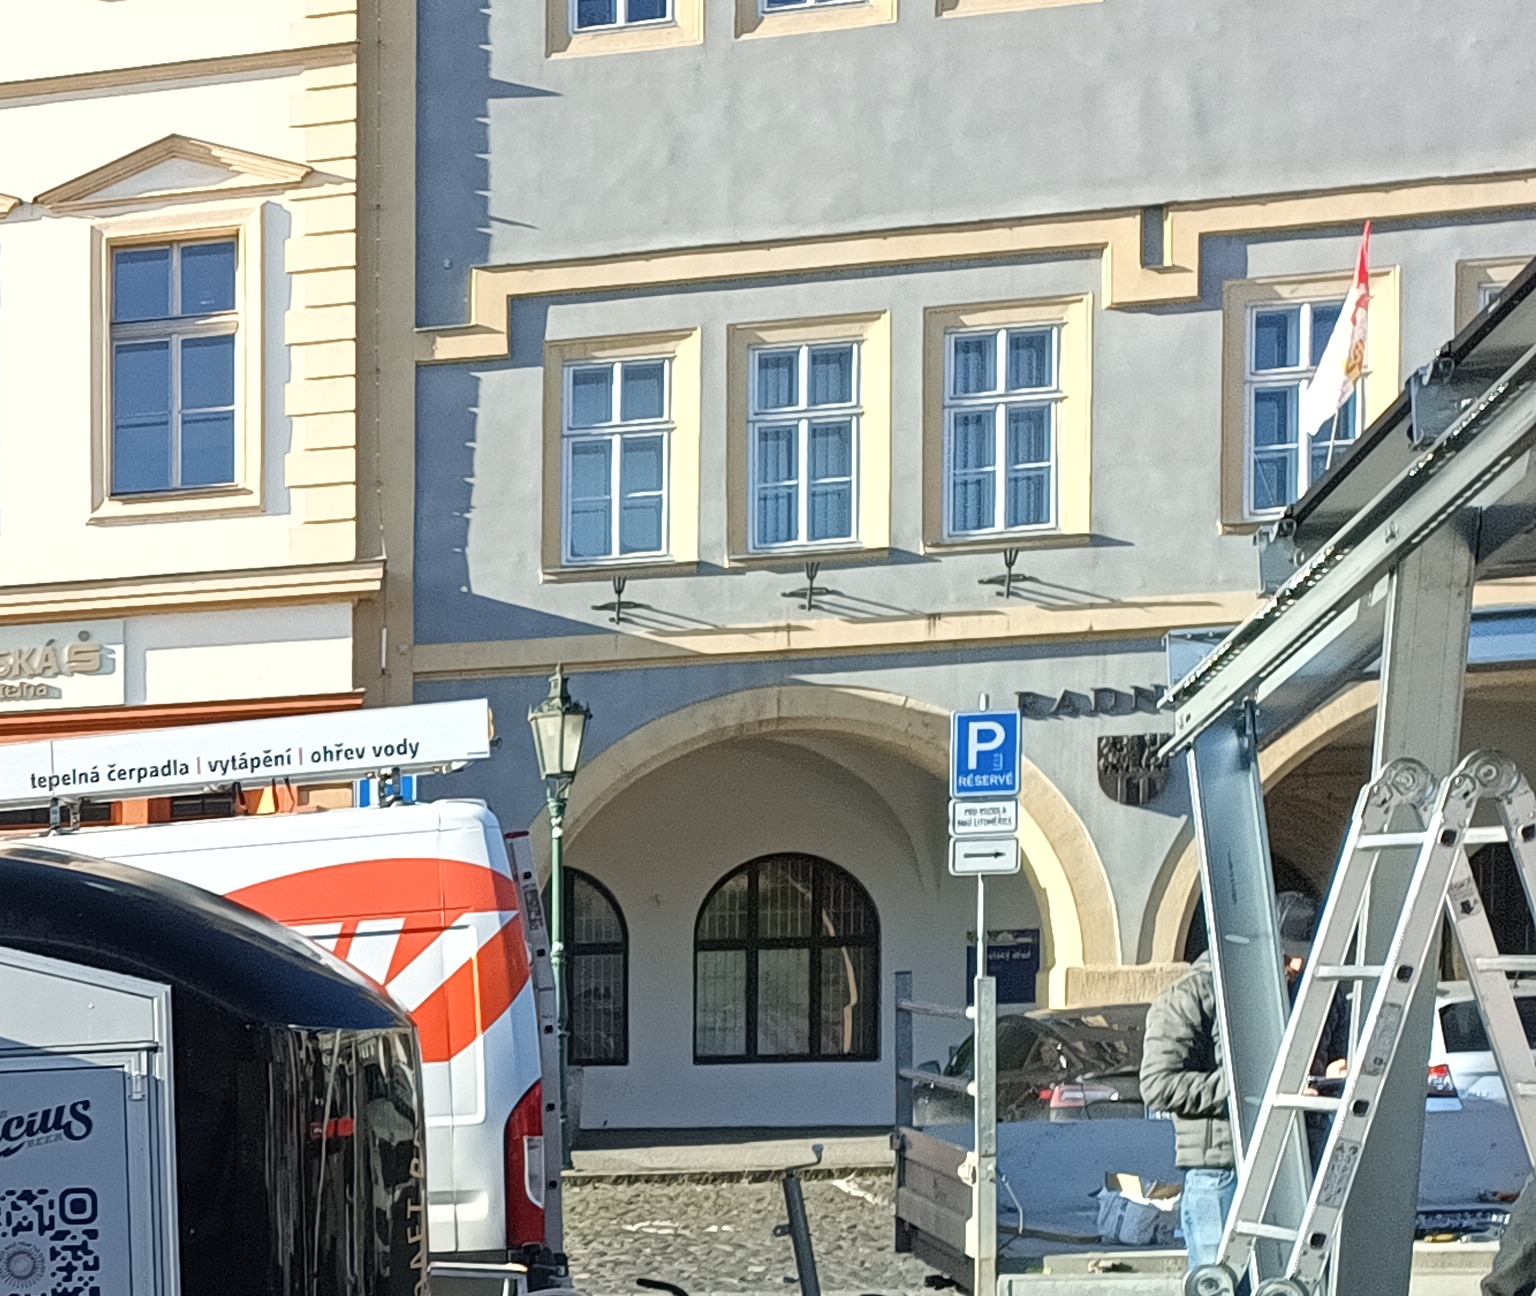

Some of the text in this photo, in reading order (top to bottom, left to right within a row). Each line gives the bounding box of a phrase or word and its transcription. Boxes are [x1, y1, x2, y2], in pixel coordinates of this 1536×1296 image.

[1015, 684, 1169, 720] RADN
[30, 738, 420, 791] tepelná čerpadla vytápění ohřev vody
[967, 721, 1006, 770] P
[26, 1133, 64, 1149] BEER
